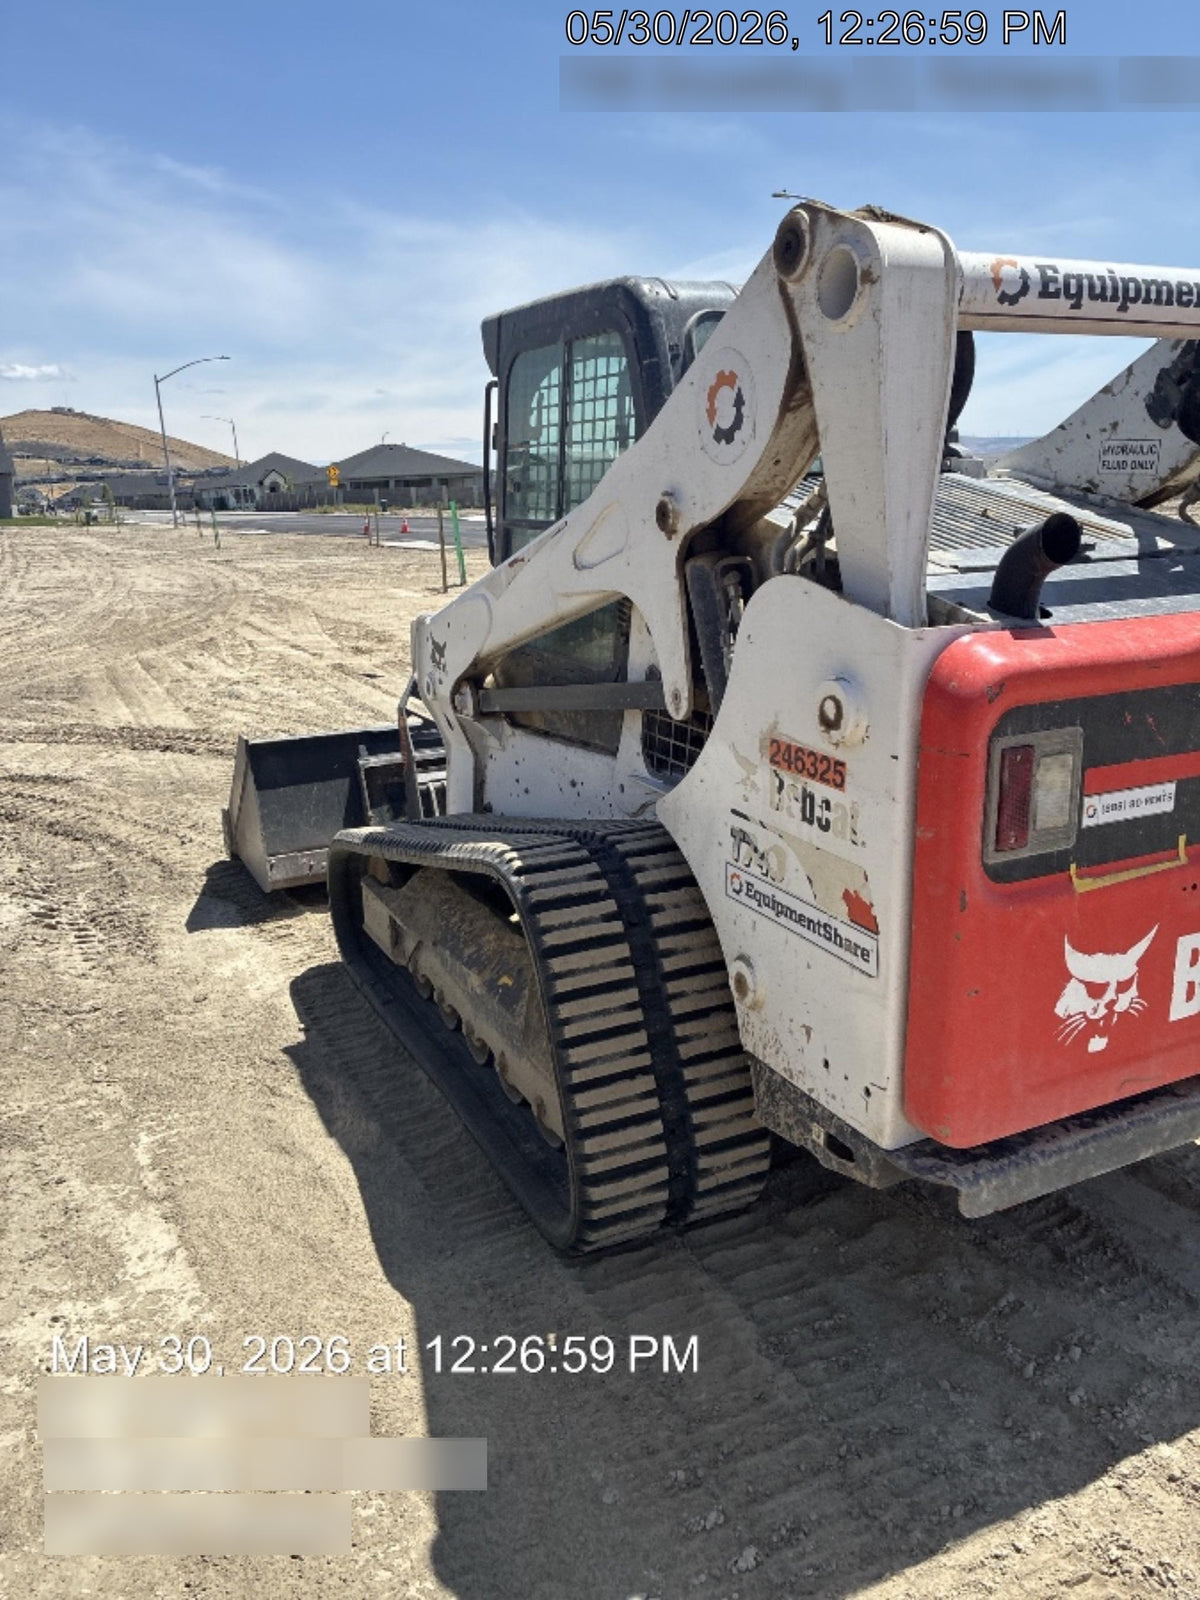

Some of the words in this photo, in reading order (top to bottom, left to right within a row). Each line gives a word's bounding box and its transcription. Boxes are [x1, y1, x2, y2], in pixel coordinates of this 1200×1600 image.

[1101, 460, 1128, 470] FLUID
[1130, 460, 1155, 470] ONLY
[1102, 444, 1157, 456] HYDRAULIC
[769, 738, 846, 790] 246325
[744, 879, 871, 964] EquipmentShare
